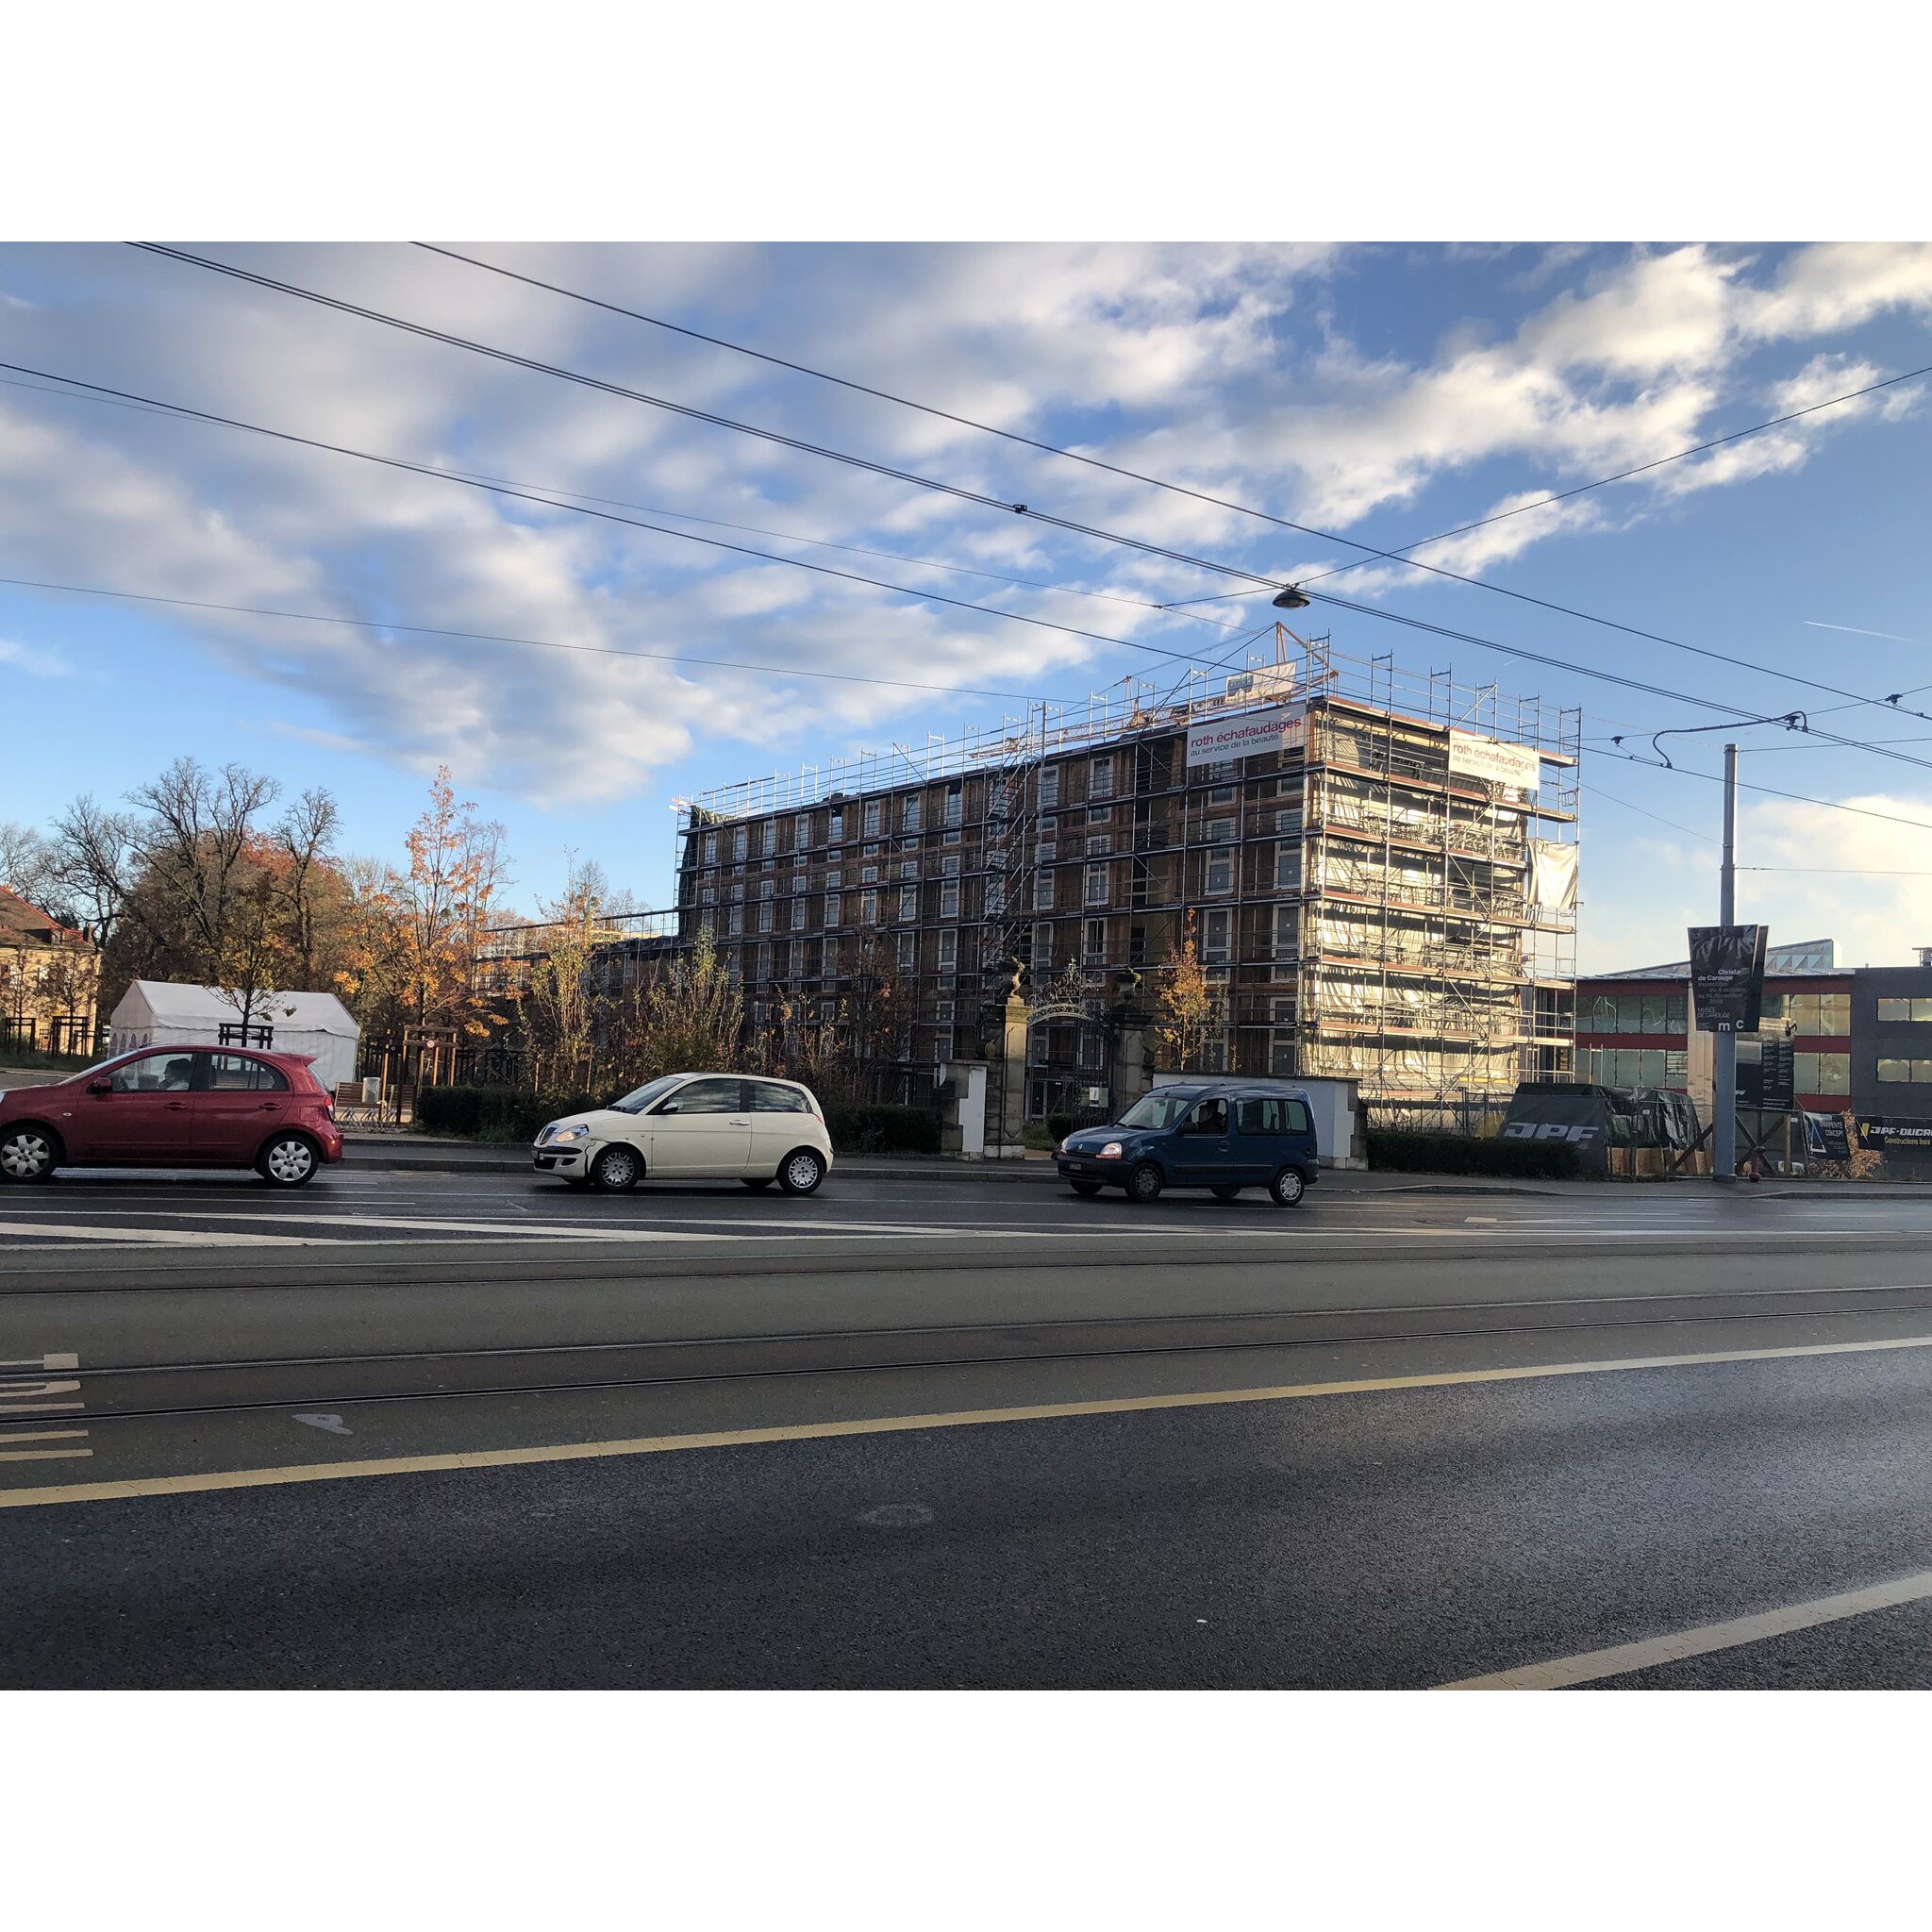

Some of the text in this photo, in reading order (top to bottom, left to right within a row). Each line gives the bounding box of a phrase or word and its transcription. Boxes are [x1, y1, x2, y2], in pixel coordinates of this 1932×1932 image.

[1191, 718, 1302, 747] roth échafaudages
[1201, 743, 1229, 754] service
[1231, 740, 1241, 749] de
[1243, 739, 1250, 747] la
[1251, 733, 1279, 744] beauté
[1453, 744, 1472, 755] roth
[1504, 1122, 1599, 1141] JPF
[1884, 1136, 1919, 1145] Constructions
